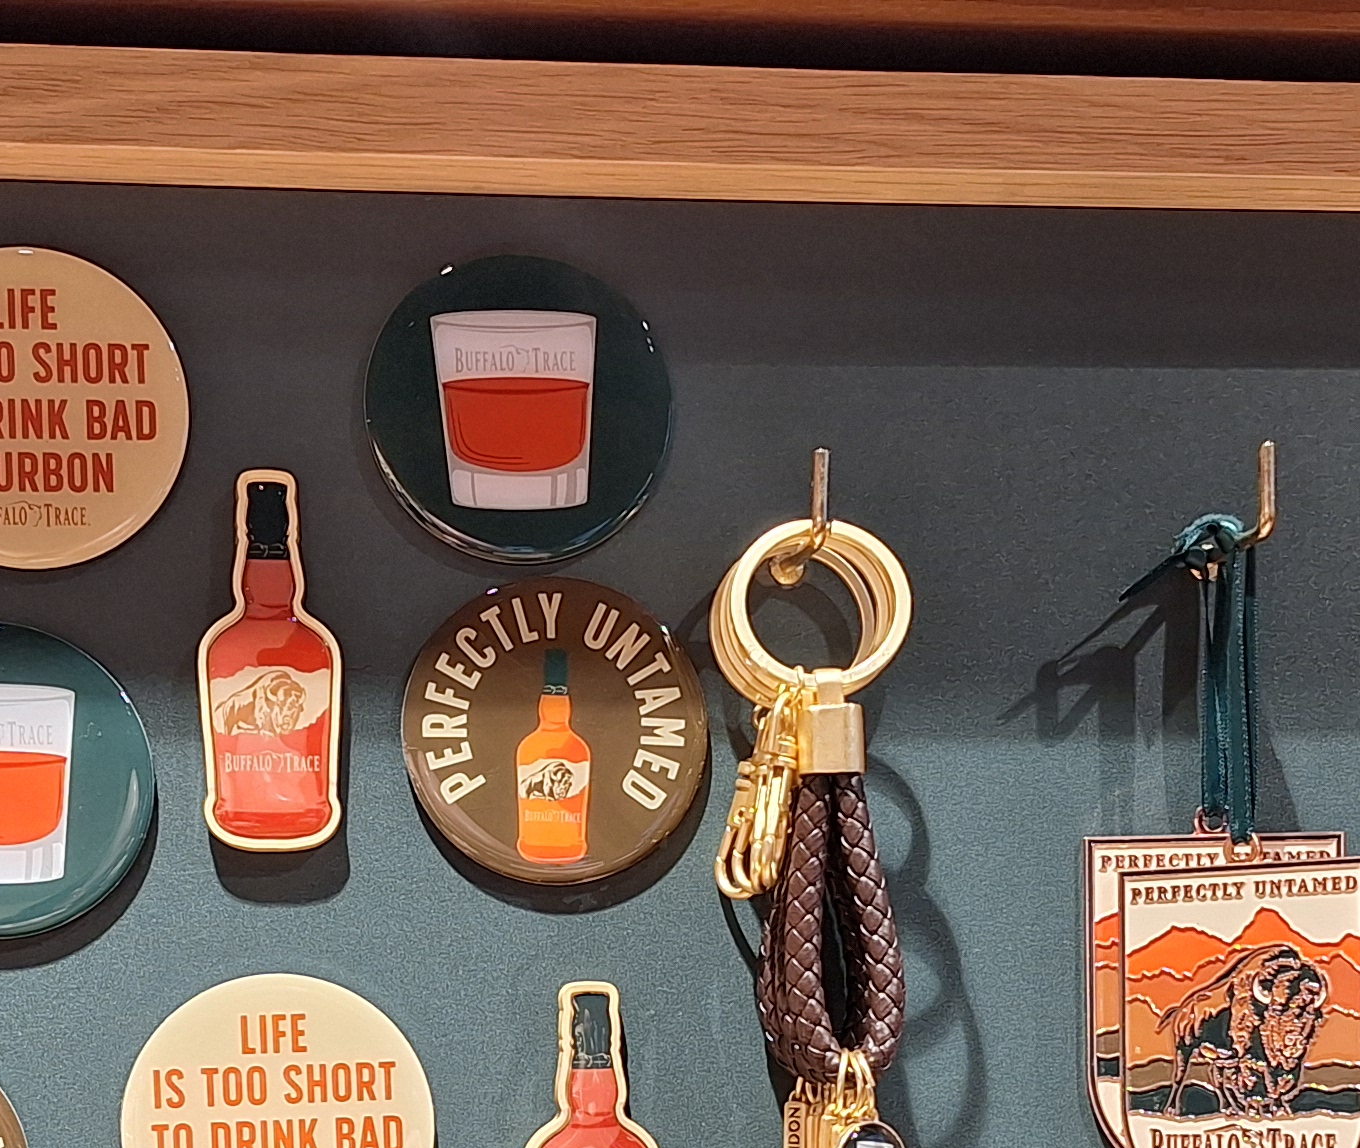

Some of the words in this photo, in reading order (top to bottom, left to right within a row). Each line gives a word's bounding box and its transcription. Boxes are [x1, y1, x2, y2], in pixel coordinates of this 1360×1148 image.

[32, 342, 150, 384] SHORT
[455, 348, 515, 372] BUFFALO
[533, 348, 576, 372] TRACE
[86, 400, 157, 441] BAD
[422, 593, 562, 805] PERFECTLY
[583, 602, 685, 810] UNTAMED
[6, 721, 53, 746] TRACE
[225, 753, 272, 773] BUFFALO
[285, 753, 320, 772] TRACE
[1100, 853, 1219, 871] PERFECTLY
[1131, 882, 1245, 904] PERFECTLY
[1254, 876, 1357, 896] UNTAMED
[240, 1013, 308, 1054] LIFE
[153, 1068, 185, 1109] IS
[201, 1065, 268, 1107] TOO
[284, 1060, 397, 1105] SHORT
